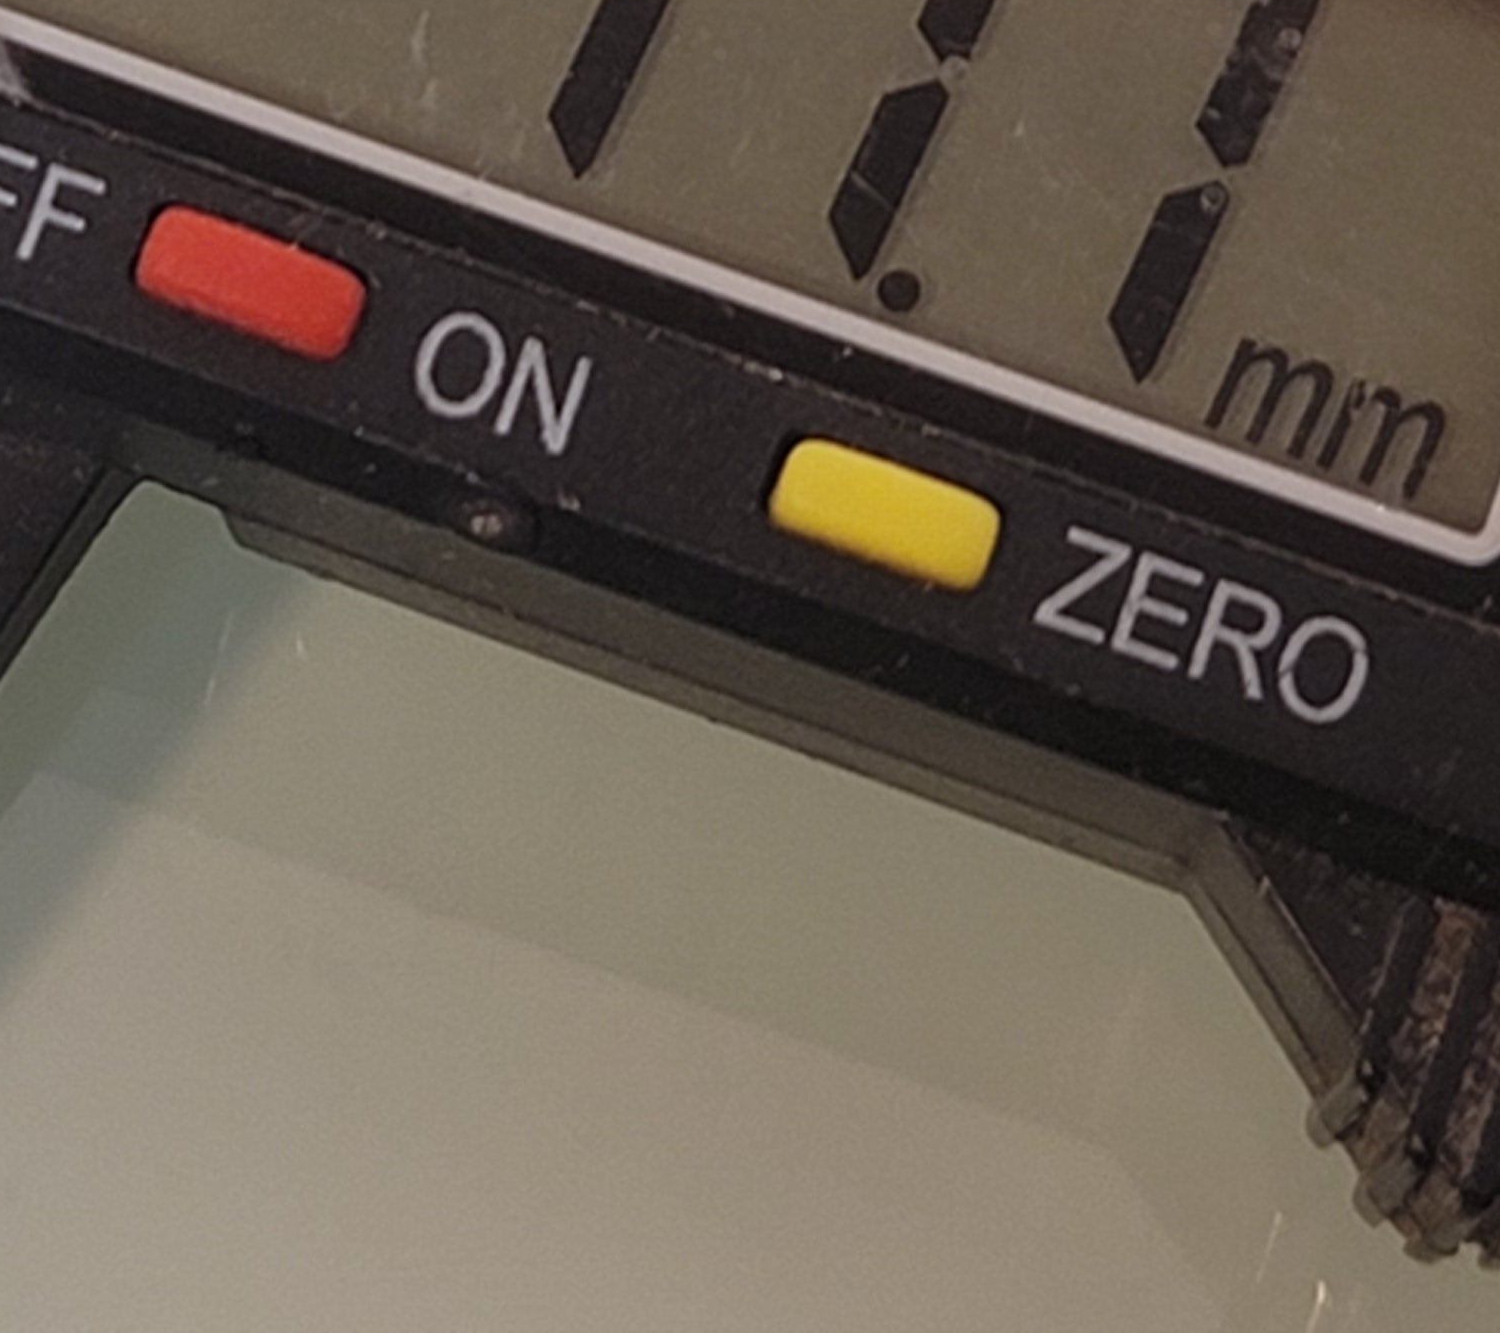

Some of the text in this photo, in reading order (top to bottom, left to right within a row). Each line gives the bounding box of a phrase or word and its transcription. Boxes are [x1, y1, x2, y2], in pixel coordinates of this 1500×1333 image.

[413, 309, 592, 458] ON
[1203, 338, 1448, 500] mm
[1032, 525, 1370, 726] ZERO
